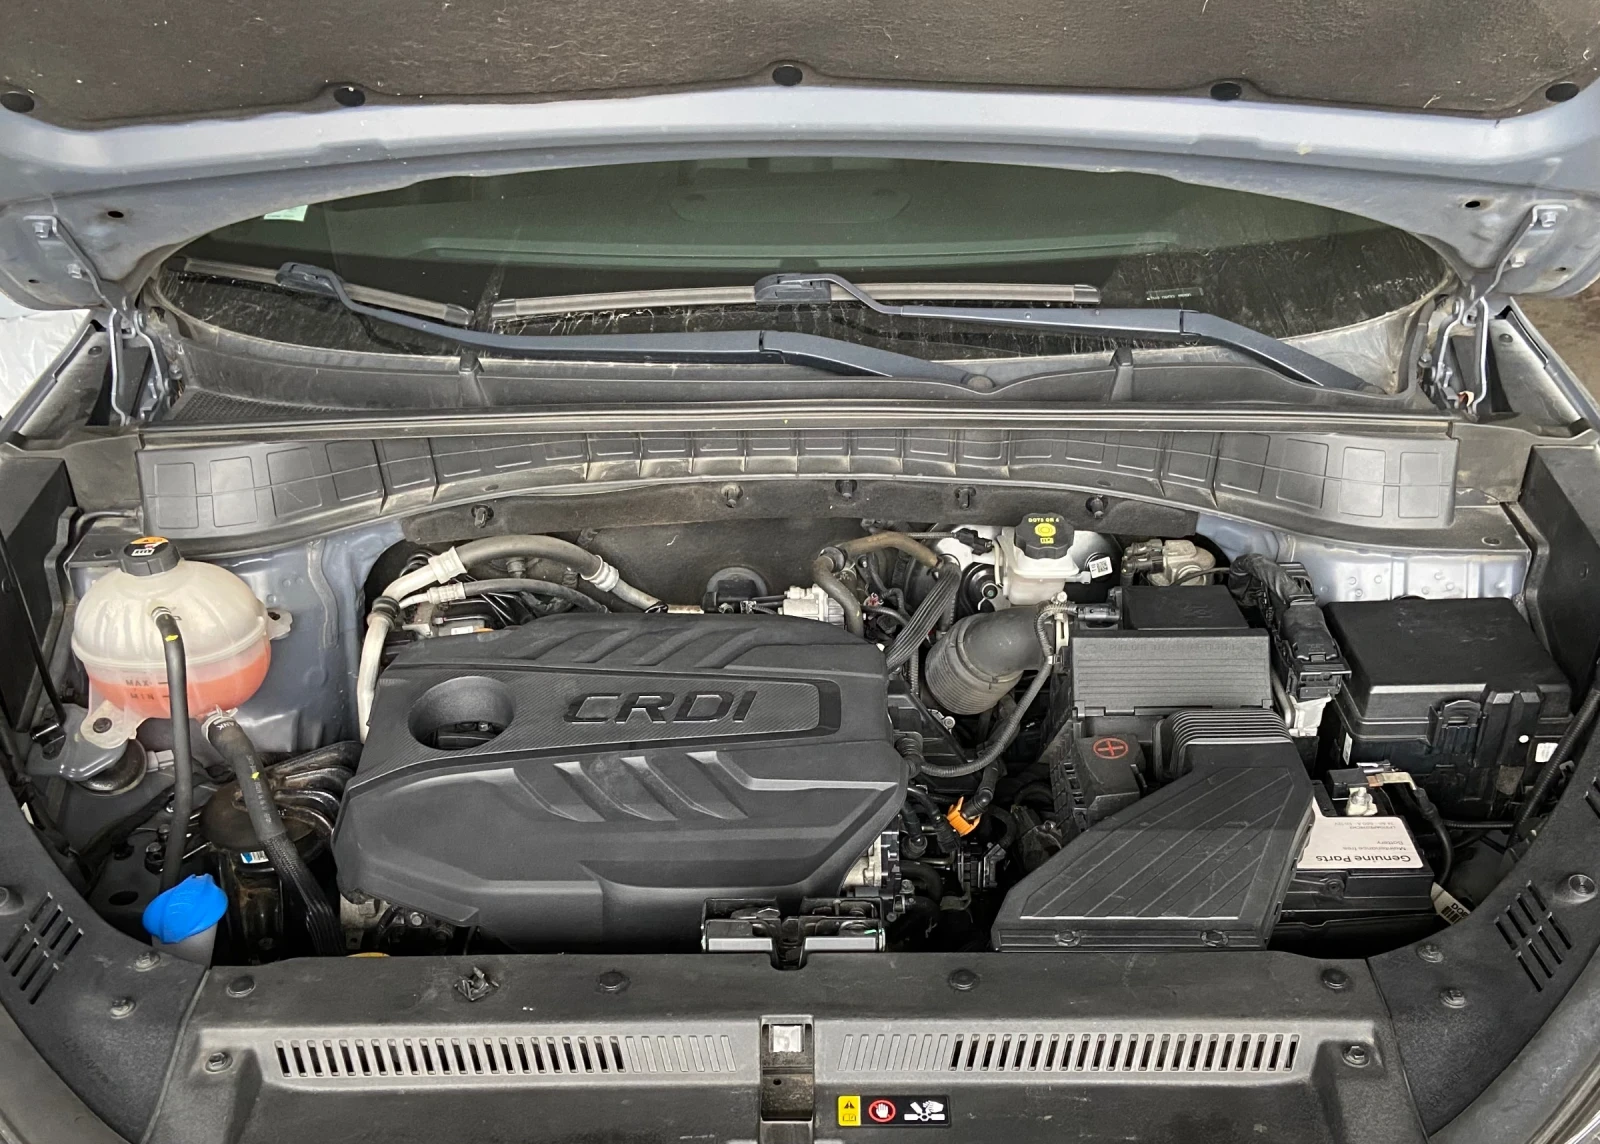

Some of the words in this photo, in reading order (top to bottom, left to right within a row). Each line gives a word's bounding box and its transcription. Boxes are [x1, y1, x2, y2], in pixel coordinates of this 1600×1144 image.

[125, 679, 149, 687] MAX
[130, 692, 154, 700] MIN
[563, 690, 757, 724] CRDI
[1315, 855, 1352, 863] Parts
[1354, 855, 1411, 863] Genuine
